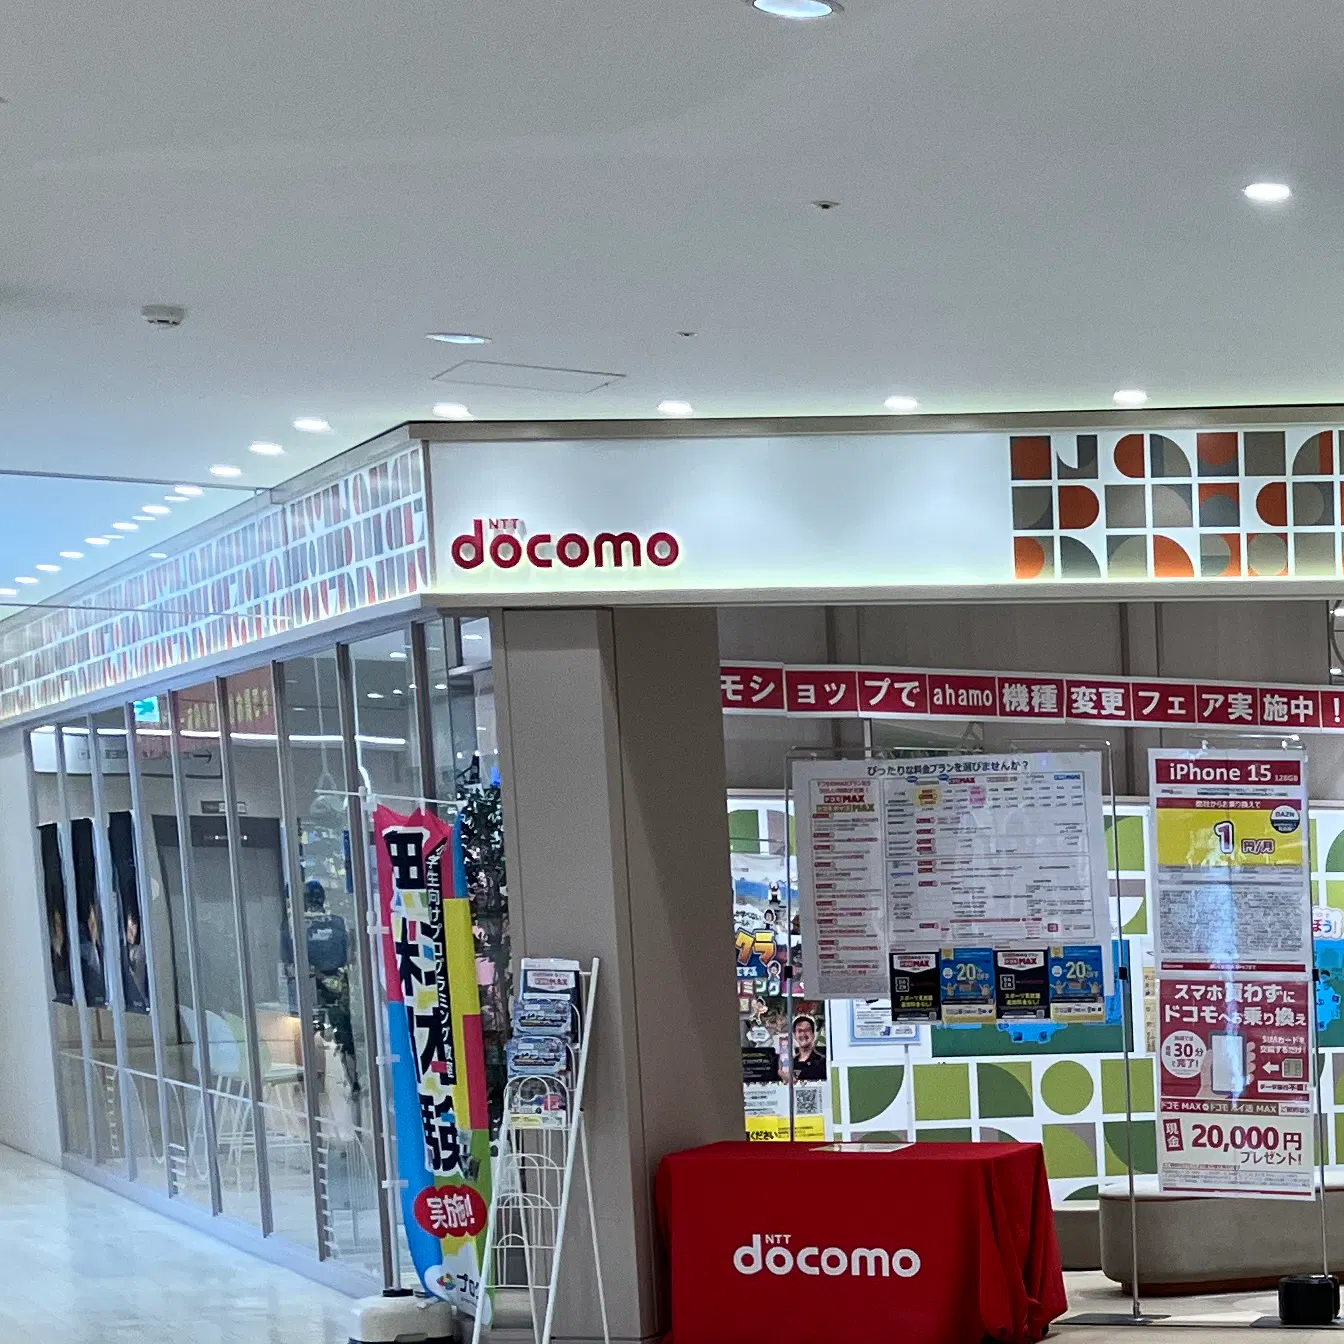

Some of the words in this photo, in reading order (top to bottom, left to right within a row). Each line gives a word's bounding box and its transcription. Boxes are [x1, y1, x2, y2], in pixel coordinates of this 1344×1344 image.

[489, 518, 518, 529] NTT
[452, 519, 679, 569] docomo
[867, 761, 1029, 776] ぴったりな料金プランを選びませんか？
[1170, 763, 1241, 781] iPhone
[1248, 765, 1271, 782] 15
[843, 795, 865, 803] MAX
[1215, 822, 1234, 853] 1
[1242, 839, 1275, 854] 円/月
[1164, 1004, 1307, 1026] ドコモへお乗り換え
[1161, 1101, 1179, 1110] ドコモ
[1182, 1102, 1201, 1111] MAX
[1210, 1103, 1228, 1112] ドコモ
[1256, 1105, 1277, 1113] MAX
[1166, 1122, 1181, 1148] 現金
[1240, 1151, 1302, 1165] プレゼント！
[765, 1234, 791, 1244] NTT
[734, 1234, 921, 1277] docomo
